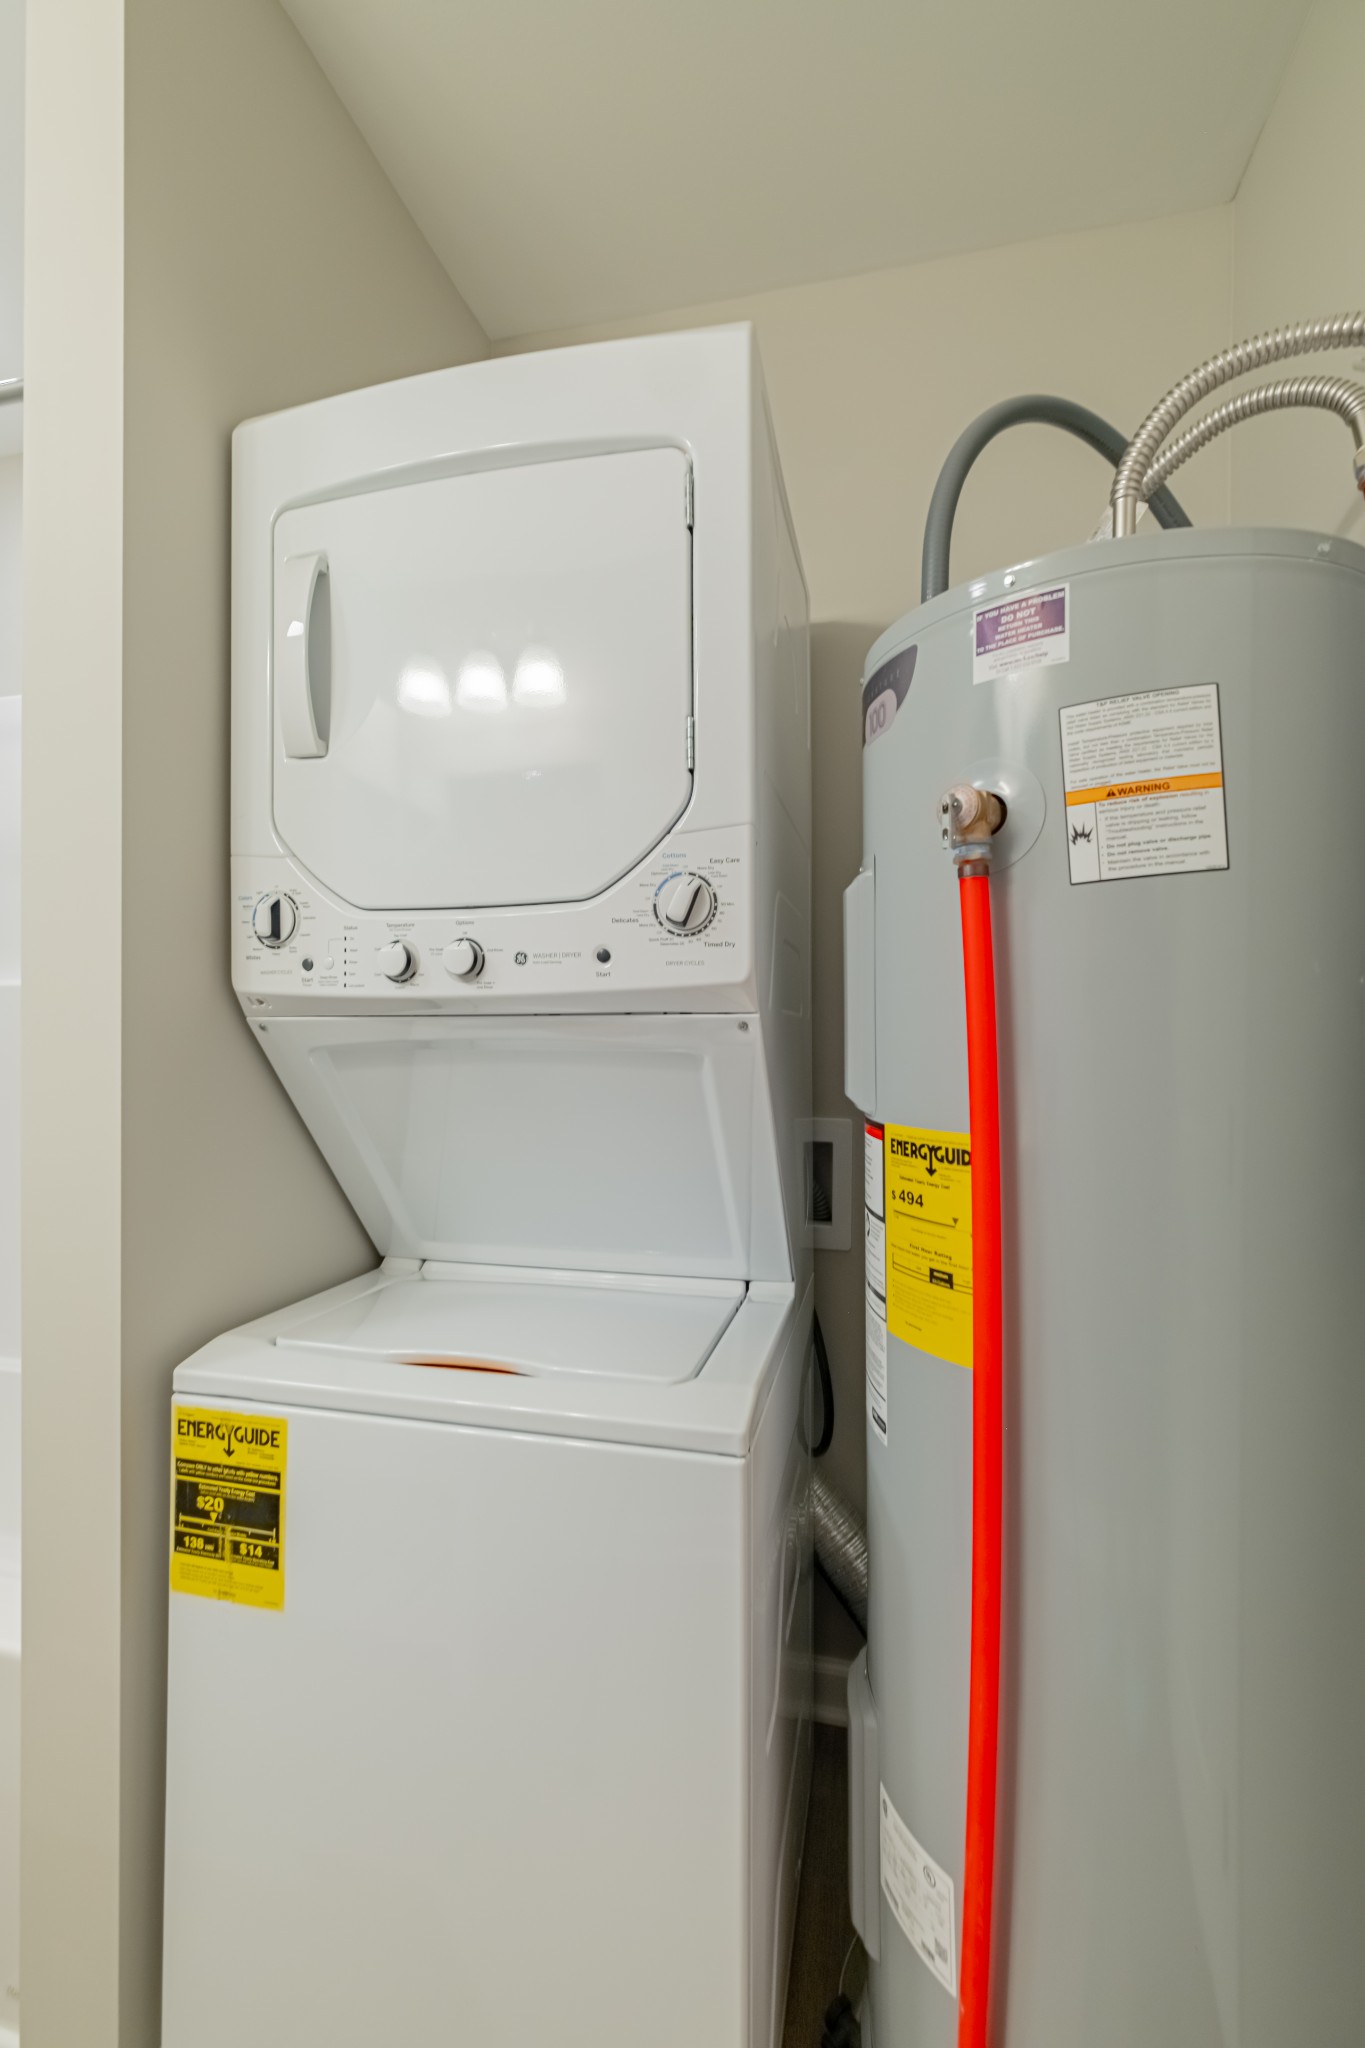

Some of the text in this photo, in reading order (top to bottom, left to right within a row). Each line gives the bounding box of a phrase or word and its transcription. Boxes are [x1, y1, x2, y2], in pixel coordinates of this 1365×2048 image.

[985, 610, 999, 619] YOU
[1000, 605, 1019, 614] HAVE
[1028, 592, 1064, 605] PROBLEM
[1001, 607, 1037, 624] DO NOT
[995, 622, 1043, 640] WATER HEATER
[998, 616, 1040, 632] RETURN THIS
[998, 638, 1017, 647] PLACE
[1118, 782, 1170, 796] WARNING
[891, 1138, 971, 1166] ENERGYGUID
[927, 1181, 940, 1189] Energy
[899, 1189, 924, 1208] 494
[934, 1251, 952, 1261] Rating
[178, 1418, 280, 1448] ENERGYGUIDE
[231, 1488, 245, 1496] Energy
[197, 1496, 224, 1512] $20
[184, 1536, 204, 1550] 138
[240, 1543, 262, 1558] $14
